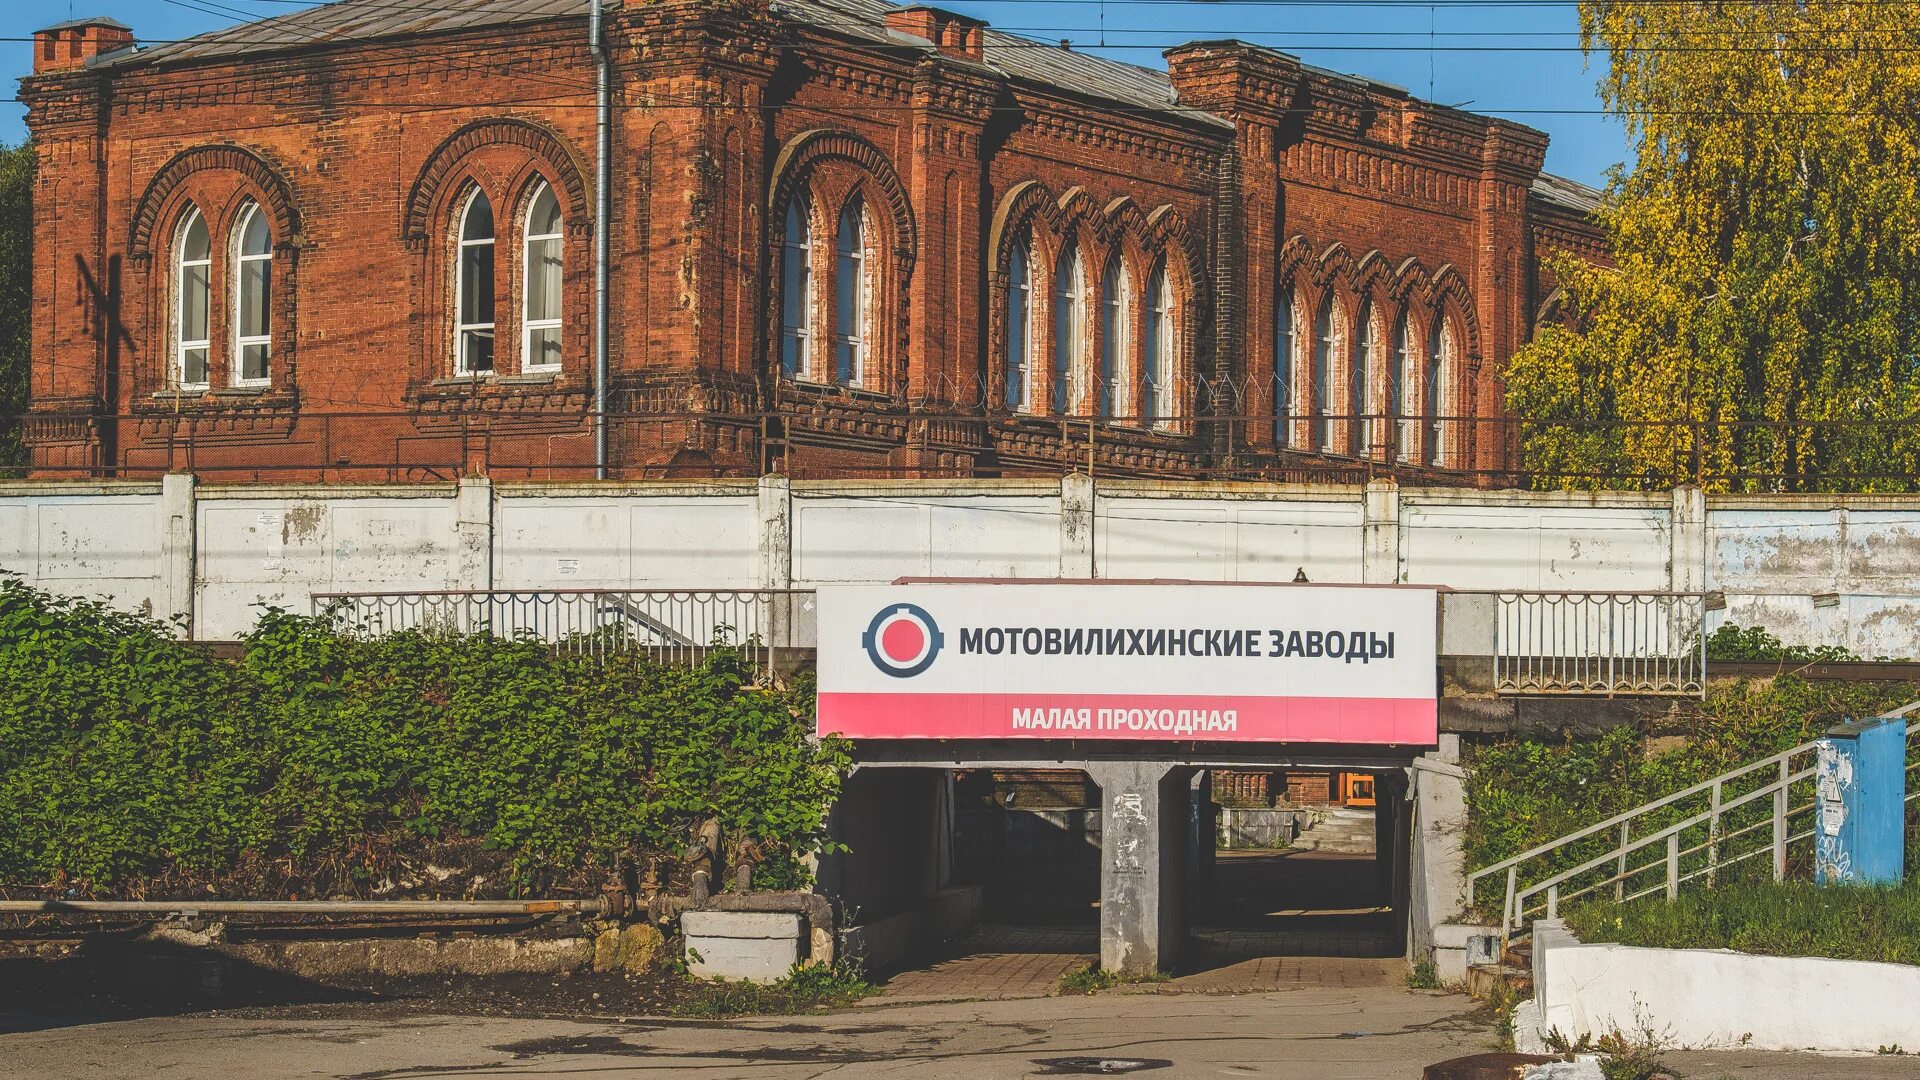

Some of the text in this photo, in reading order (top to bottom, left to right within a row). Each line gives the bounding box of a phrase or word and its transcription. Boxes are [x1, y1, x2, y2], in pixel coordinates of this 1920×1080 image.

[959, 627, 1395, 664] МОТОВИЛИХИНСКИЕ ЗАВОДЫ
[1012, 707, 1238, 734] МАЛАЯ ПРОХОДНАЯ
